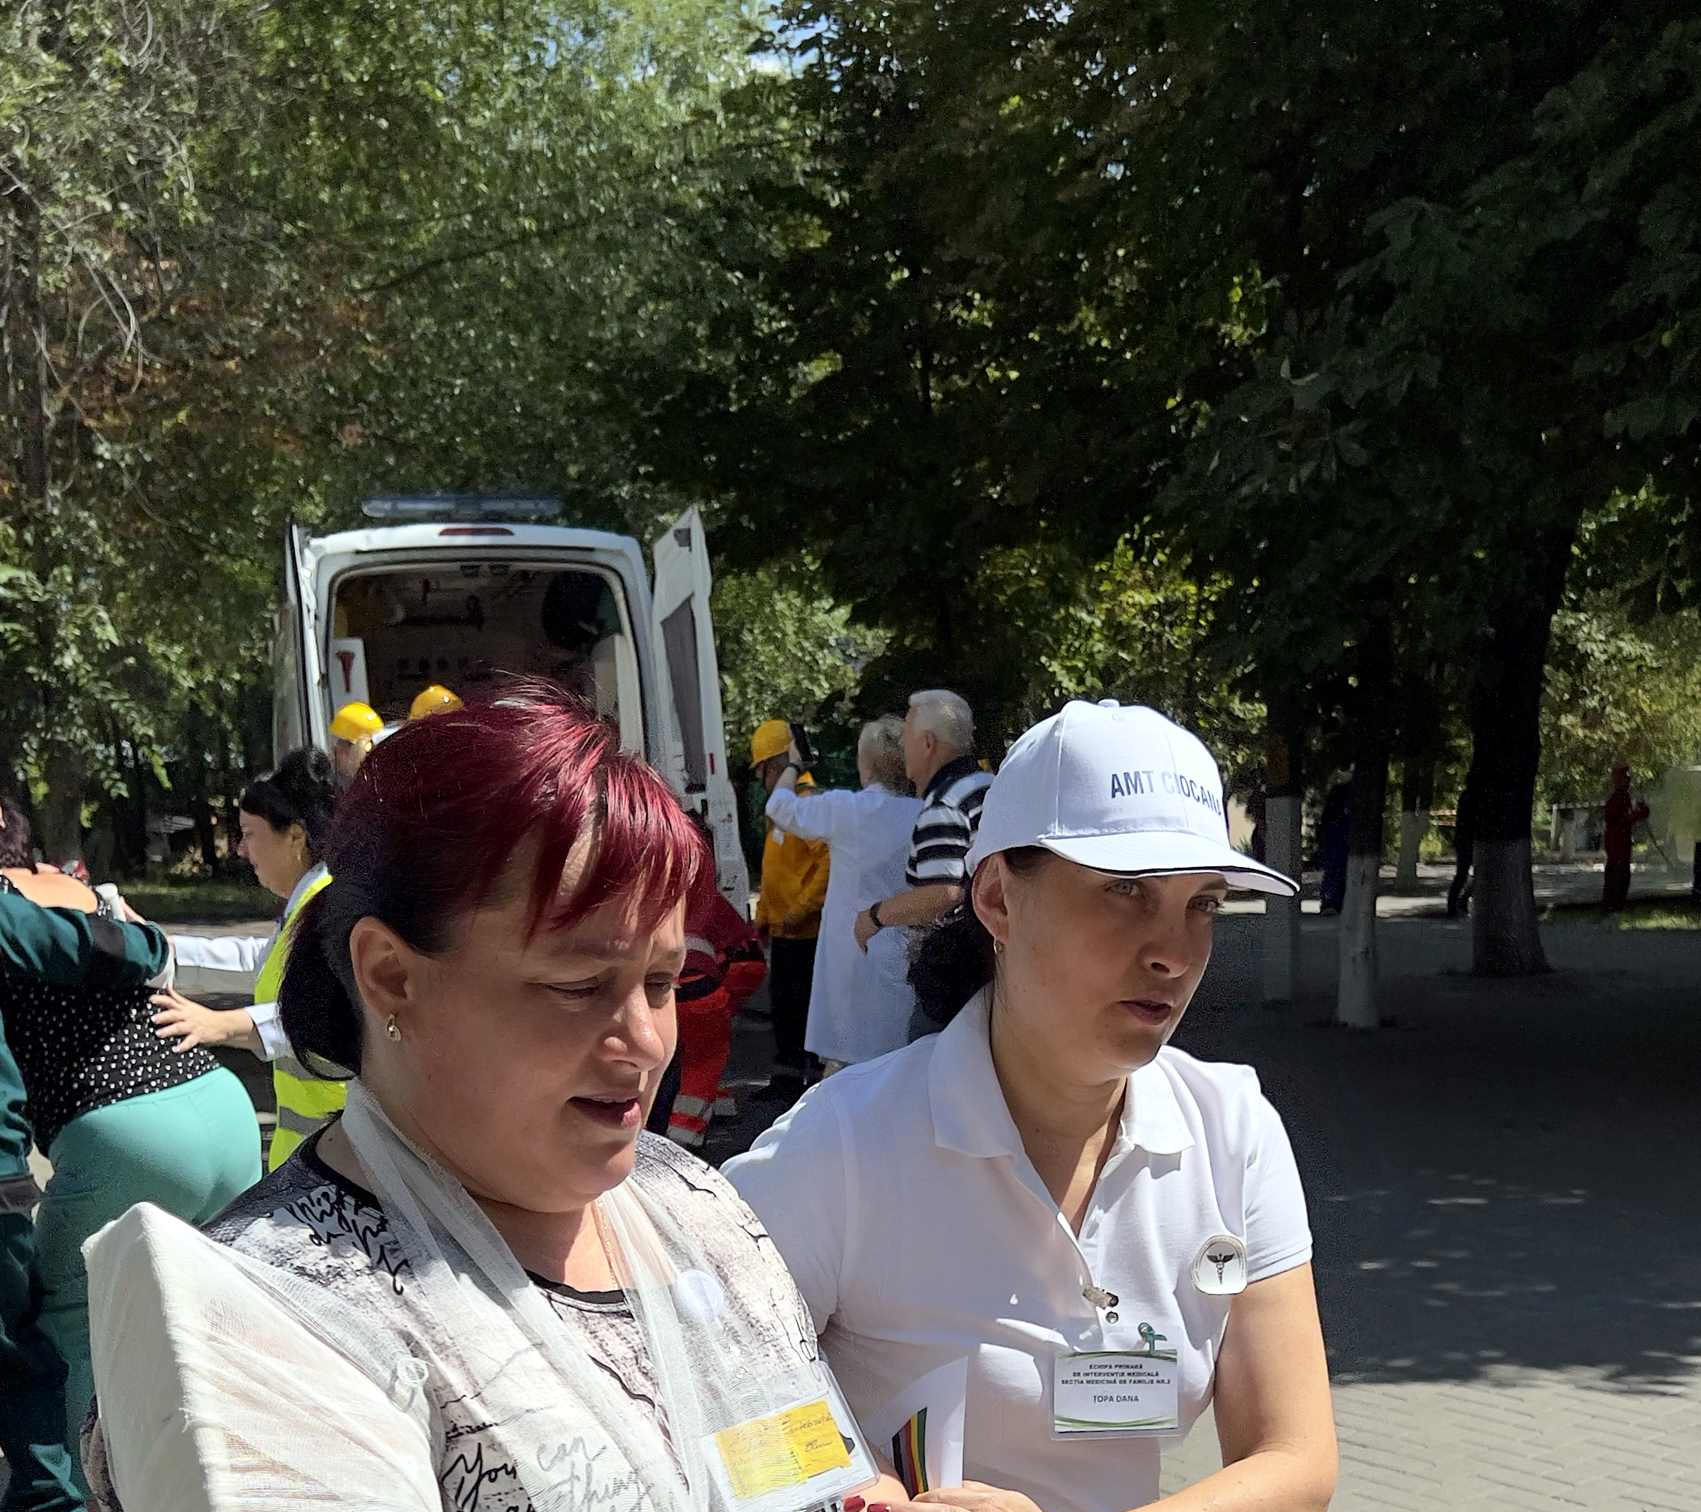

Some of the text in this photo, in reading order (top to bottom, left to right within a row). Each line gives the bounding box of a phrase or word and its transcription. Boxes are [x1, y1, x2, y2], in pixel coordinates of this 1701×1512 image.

[1110, 770, 1155, 799] AMT
[1115, 1394, 1140, 1403] DANA
[440, 1442, 517, 1511] You
